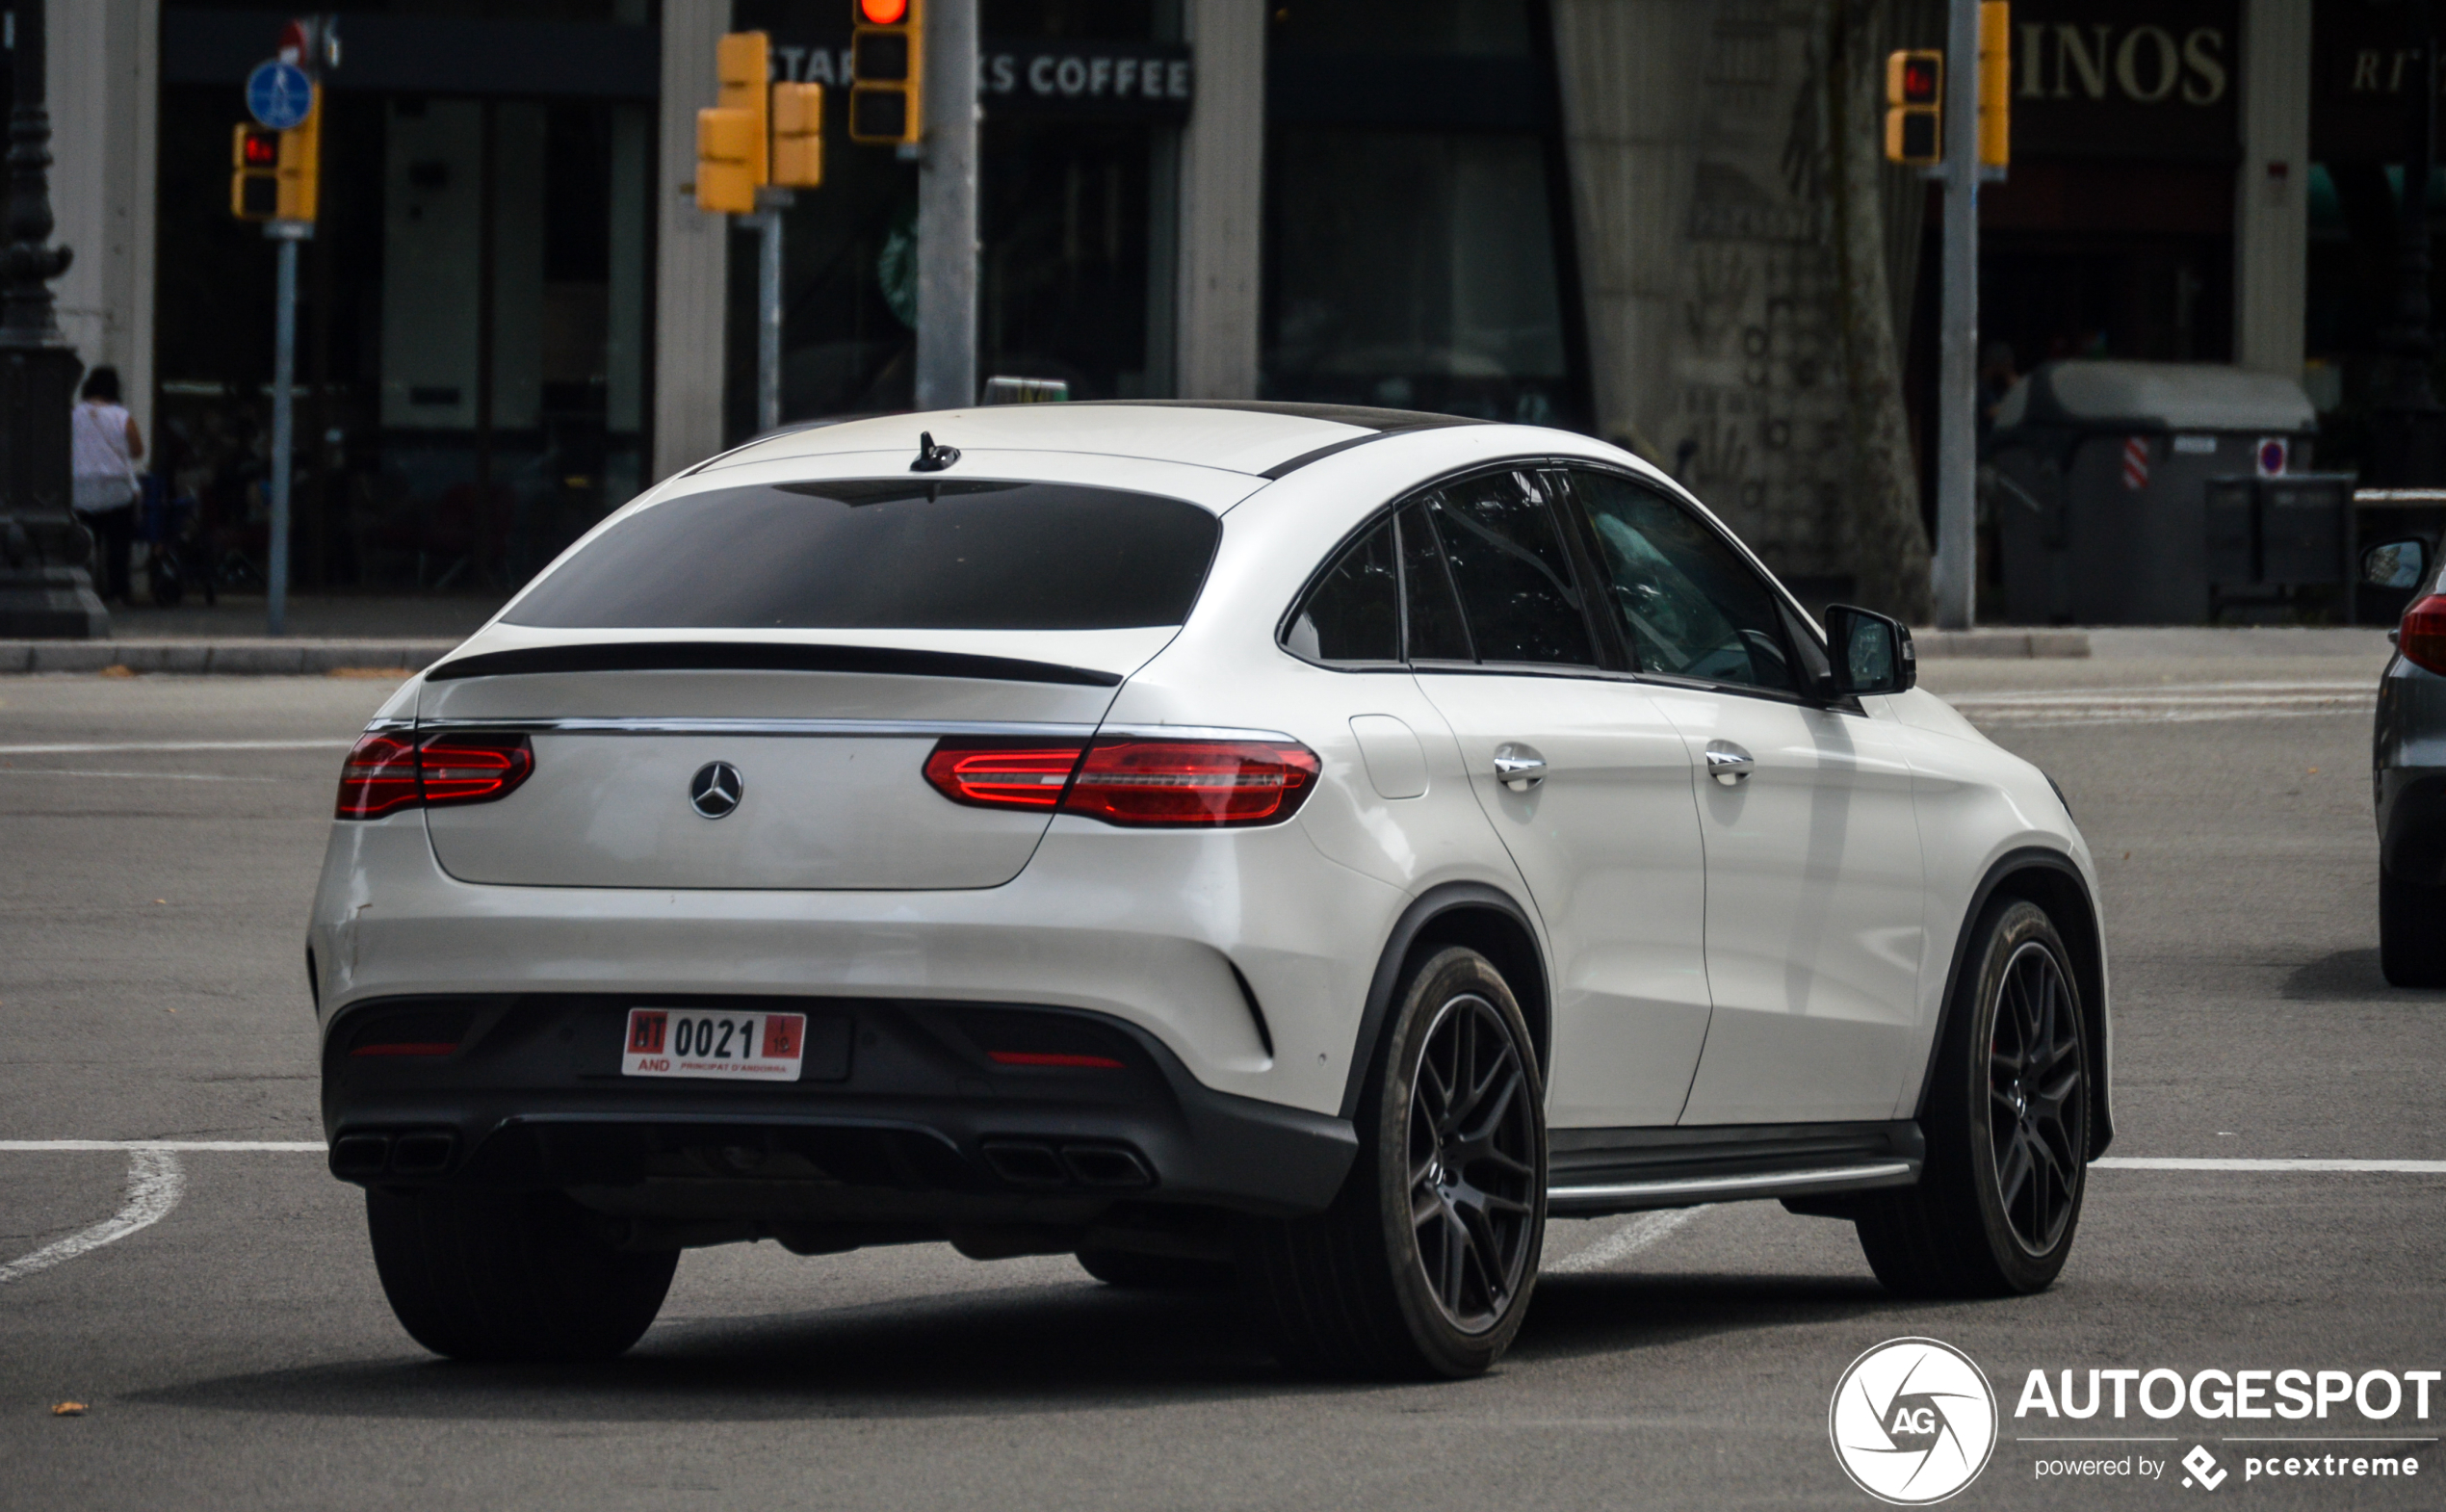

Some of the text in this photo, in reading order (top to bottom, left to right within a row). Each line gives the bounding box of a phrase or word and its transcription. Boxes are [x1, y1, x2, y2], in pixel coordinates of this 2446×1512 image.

[1028, 56, 1190, 96] COFFEE
[2017, 22, 2227, 106] INOS
[675, 1018, 754, 1059] 0021
[638, 1059, 670, 1072] AND
[681, 1062, 729, 1071] PRINCIPAT
